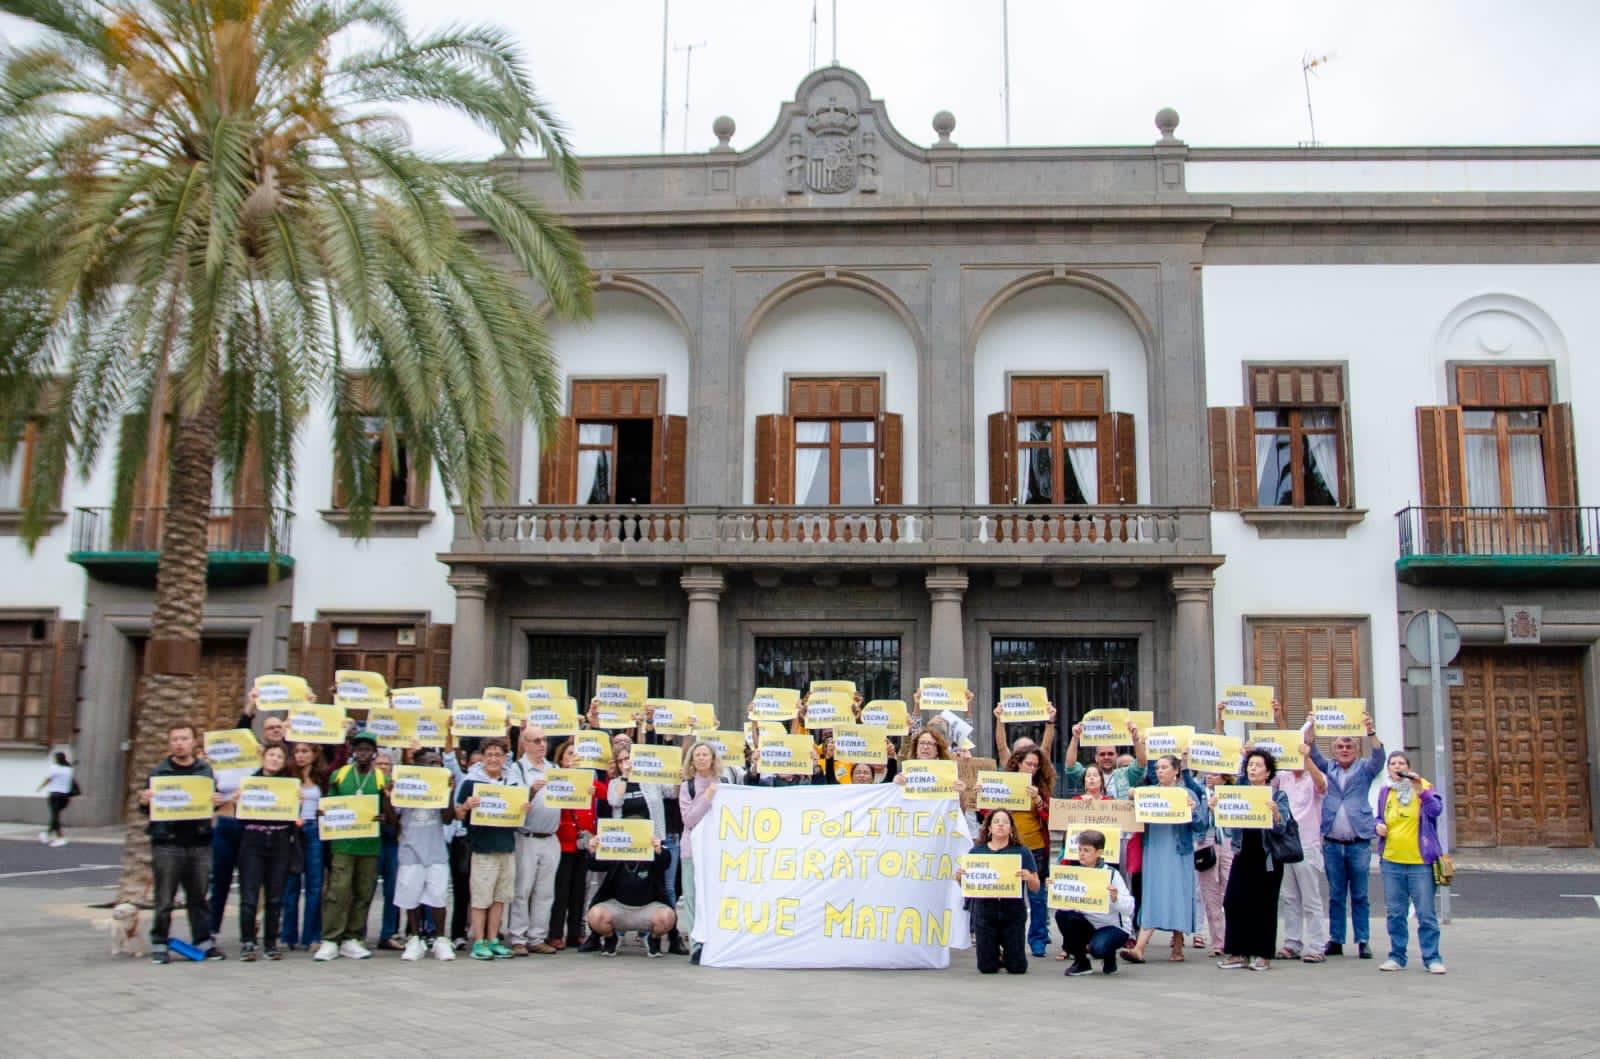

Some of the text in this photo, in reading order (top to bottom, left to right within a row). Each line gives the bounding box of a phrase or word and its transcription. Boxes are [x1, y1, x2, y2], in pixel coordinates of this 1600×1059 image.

[718, 805, 782, 843] NO
[718, 896, 952, 948] QUE MATAN
